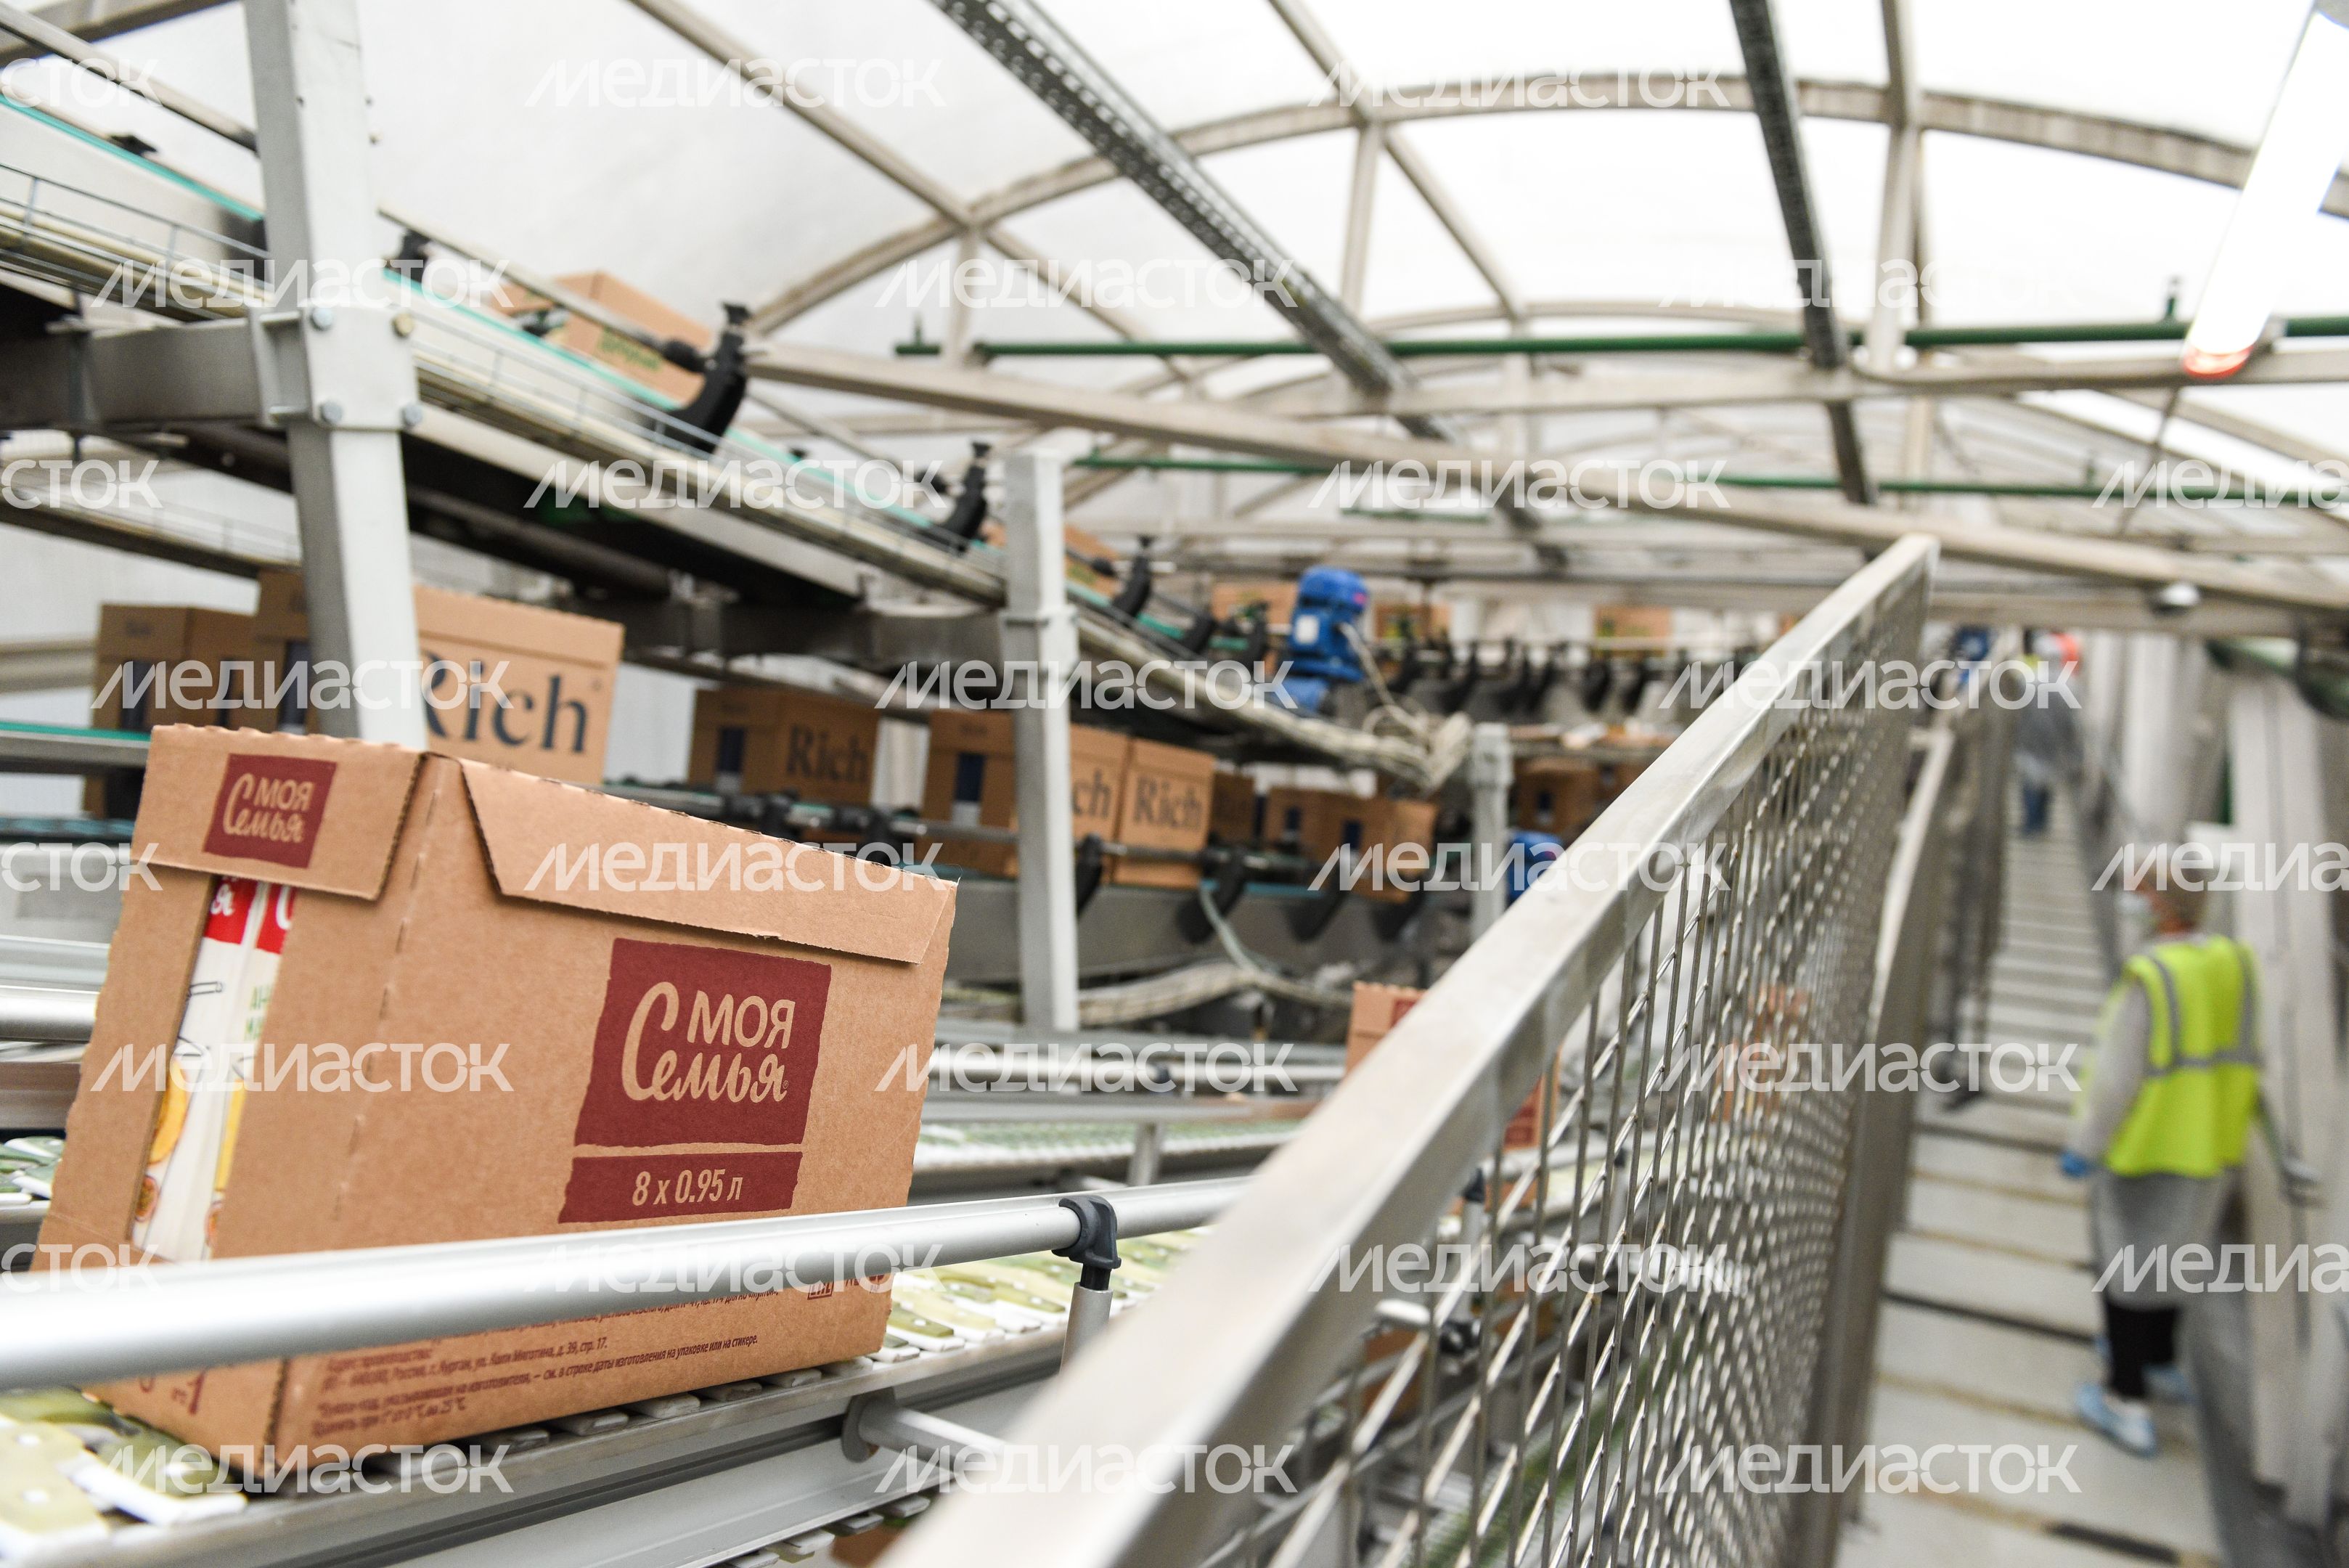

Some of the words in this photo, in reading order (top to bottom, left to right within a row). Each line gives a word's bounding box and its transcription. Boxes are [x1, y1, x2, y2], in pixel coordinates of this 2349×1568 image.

[786, 723, 869, 783] Rich
[223, 773, 306, 843] Семья
[1132, 775, 1201, 829] Rich
[632, 1171, 650, 1206] 8
[675, 1169, 725, 1203] 0.95
[727, 1177, 743, 1201] л
[565, 1363, 592, 1378] строке
[593, 1359, 614, 1373] даты
[615, 1349, 666, 1368] изготовления
[667, 1349, 676, 1359] на
[676, 1343, 709, 1360] упаковке
[709, 1340, 723, 1352] или
[722, 1339, 732, 1349] на
[732, 1334, 758, 1348] стикере.
[597, 1336, 608, 1349] 17.
